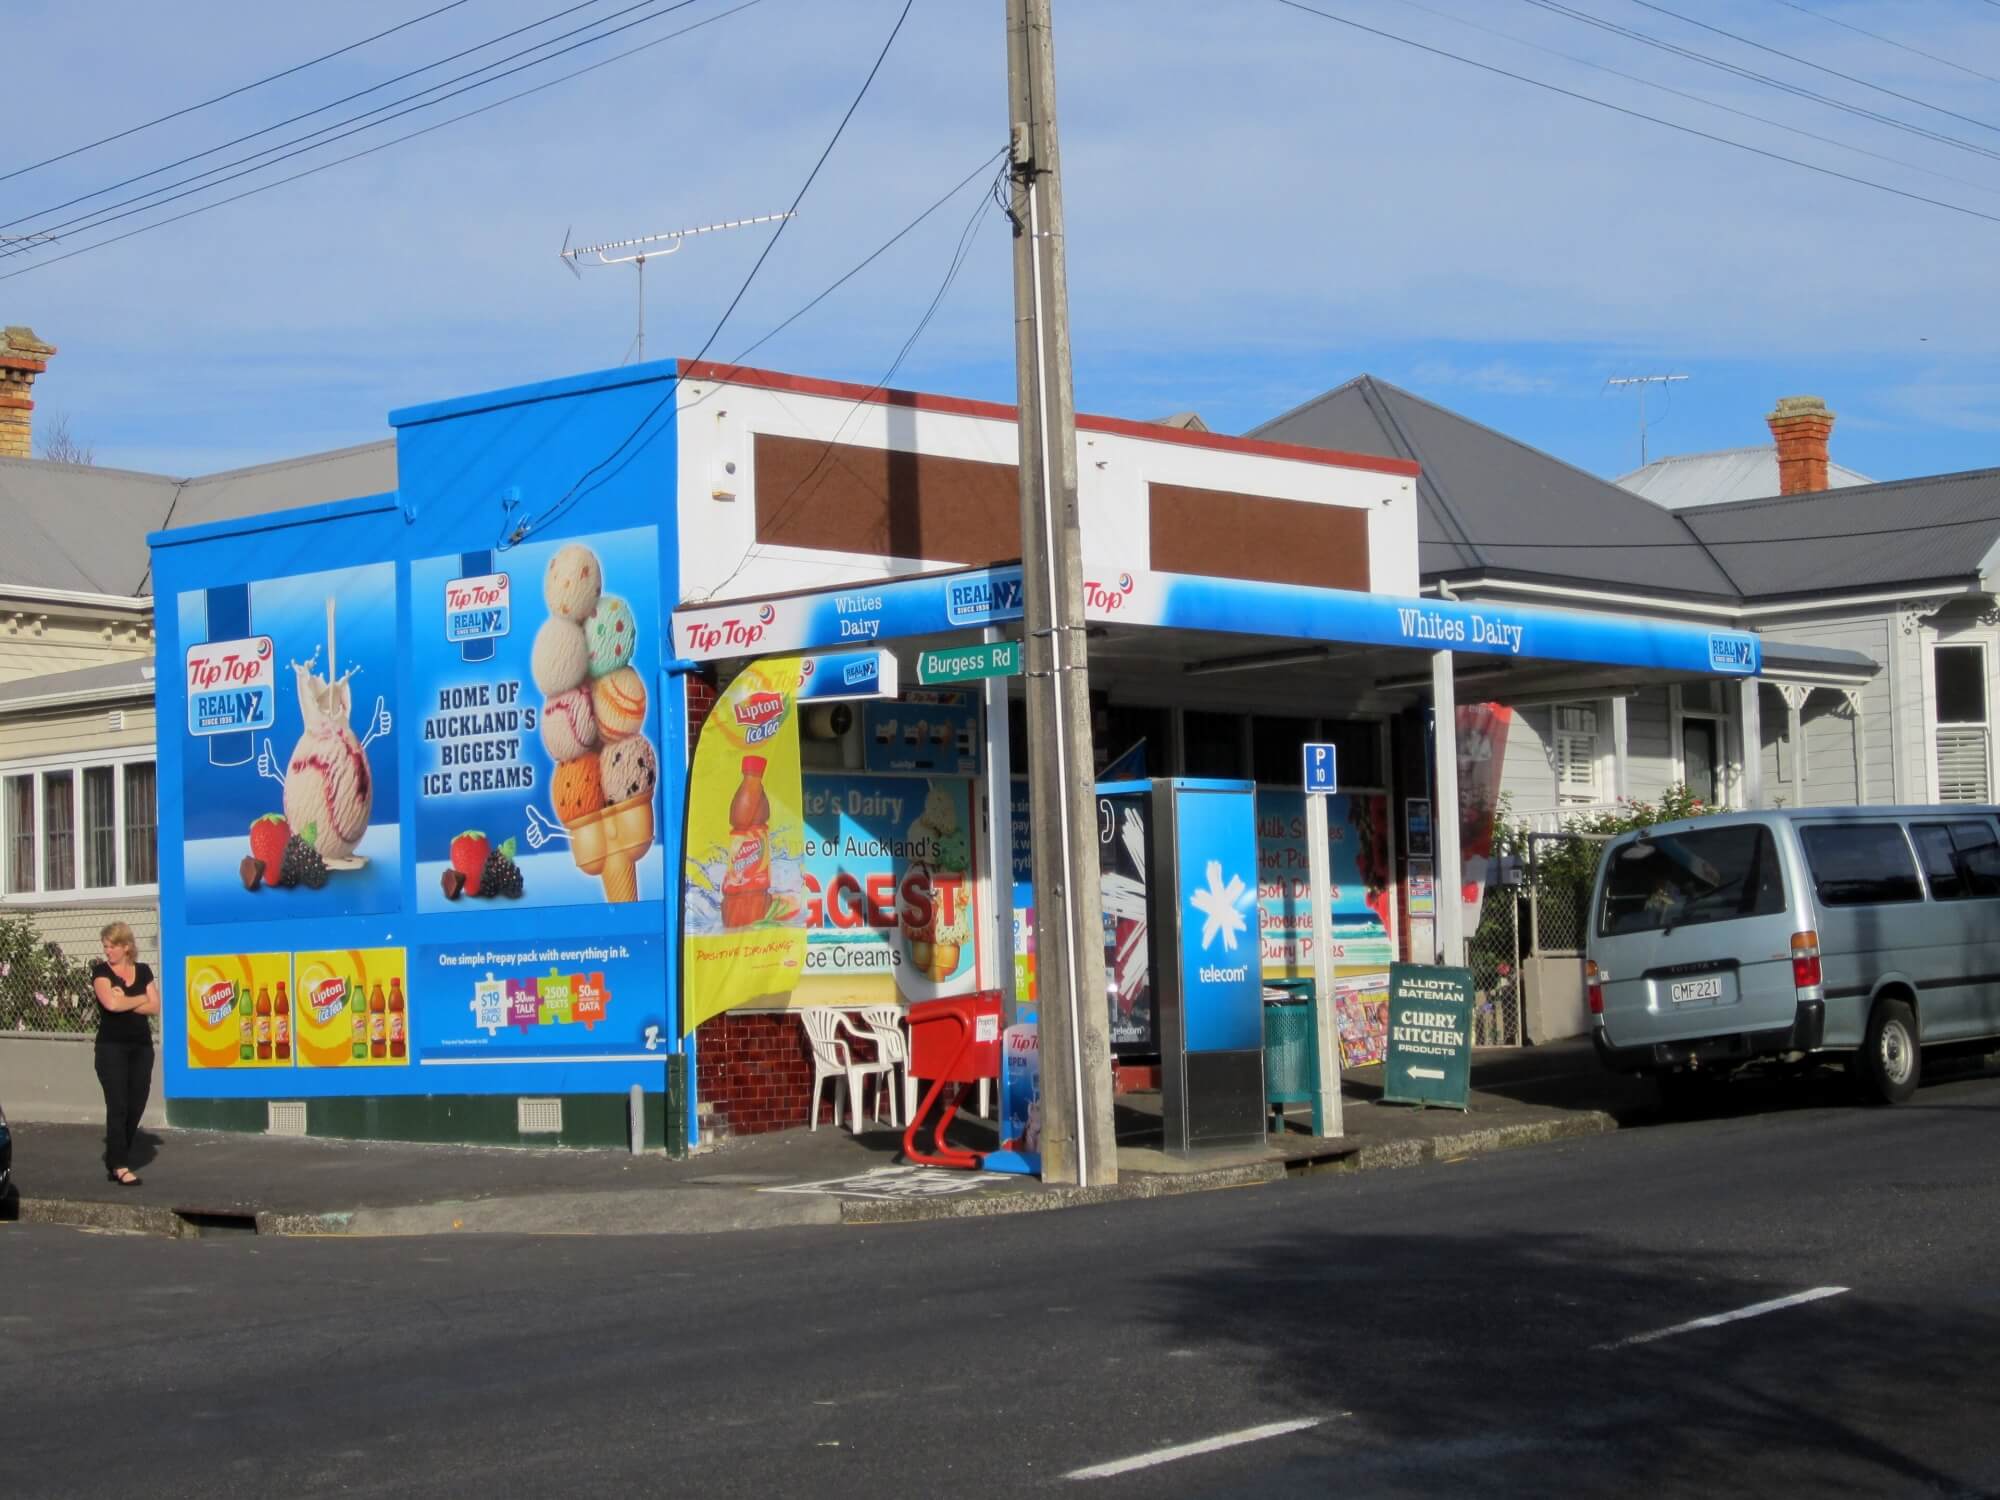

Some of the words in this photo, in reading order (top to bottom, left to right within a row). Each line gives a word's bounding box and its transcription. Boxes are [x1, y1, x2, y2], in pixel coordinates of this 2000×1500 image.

[448, 588, 471, 609] Tip
[472, 586, 499, 605] Top
[835, 595, 882, 614] Whites
[953, 584, 992, 605] REAL
[992, 580, 1024, 610] NZ
[1084, 582, 1122, 613] Top
[455, 613, 480, 628] REAL
[481, 610, 501, 632] NZ
[840, 618, 880, 637] Dairy
[1398, 607, 1465, 641] Whites
[1472, 615, 1523, 653] Dairy
[686, 624, 721, 652] Tip
[723, 619, 764, 647] Top
[928, 652, 984, 675] Burgess
[992, 649, 1011, 669] Rd
[1712, 640, 1735, 655] REAL
[1735, 642, 1752, 664] NZ
[189, 658, 220, 688] Tip
[223, 655, 260, 683] Top
[439, 685, 489, 710] HOME
[497, 682, 519, 703] OF
[198, 695, 235, 717] REAL
[236, 691, 264, 723] NZ
[738, 700, 779, 720] Lipton
[424, 709, 535, 740] AUCKLAND'S
[441, 739, 519, 766] BIGGEST
[1316, 748, 1326, 766] P
[423, 772, 452, 795] ICE
[459, 766, 533, 792] CREAMS
[1316, 768, 1325, 783] 10
[849, 790, 904, 824] Dairy
[822, 836, 840, 857] of
[845, 835, 941, 858] Auckland's
[1259, 876, 1287, 899] Soft
[803, 873, 964, 929] GGEST
[1259, 908, 1313, 929] Grocerie
[439, 954, 457, 966] One
[458, 953, 485, 967] simple
[486, 952, 516, 967] Prepay
[517, 950, 538, 966] pack
[539, 949, 559, 962] with
[560, 947, 608, 963] everything
[609, 946, 618, 958] in
[697, 947, 740, 961] POSITIVE
[804, 950, 827, 967] ce
[832, 946, 901, 967] Creams
[1200, 964, 1245, 982] telecom
[203, 987, 231, 1005] Lipton
[311, 984, 342, 1003] Lipton
[481, 991, 500, 1007] $19
[1398, 989, 1465, 1002] BATEMAN
[1673, 980, 1719, 1001] CMF221
[515, 1004, 536, 1015] TALK
[579, 1002, 600, 1012] DATA
[1401, 1011, 1457, 1029] CURRY
[1011, 1034, 1031, 1051] Tip
[1393, 1026, 1465, 1047] KITCHEN
[1398, 1044, 1456, 1056] PRODUCTS
[1008, 1057, 1027, 1067] OPEN
